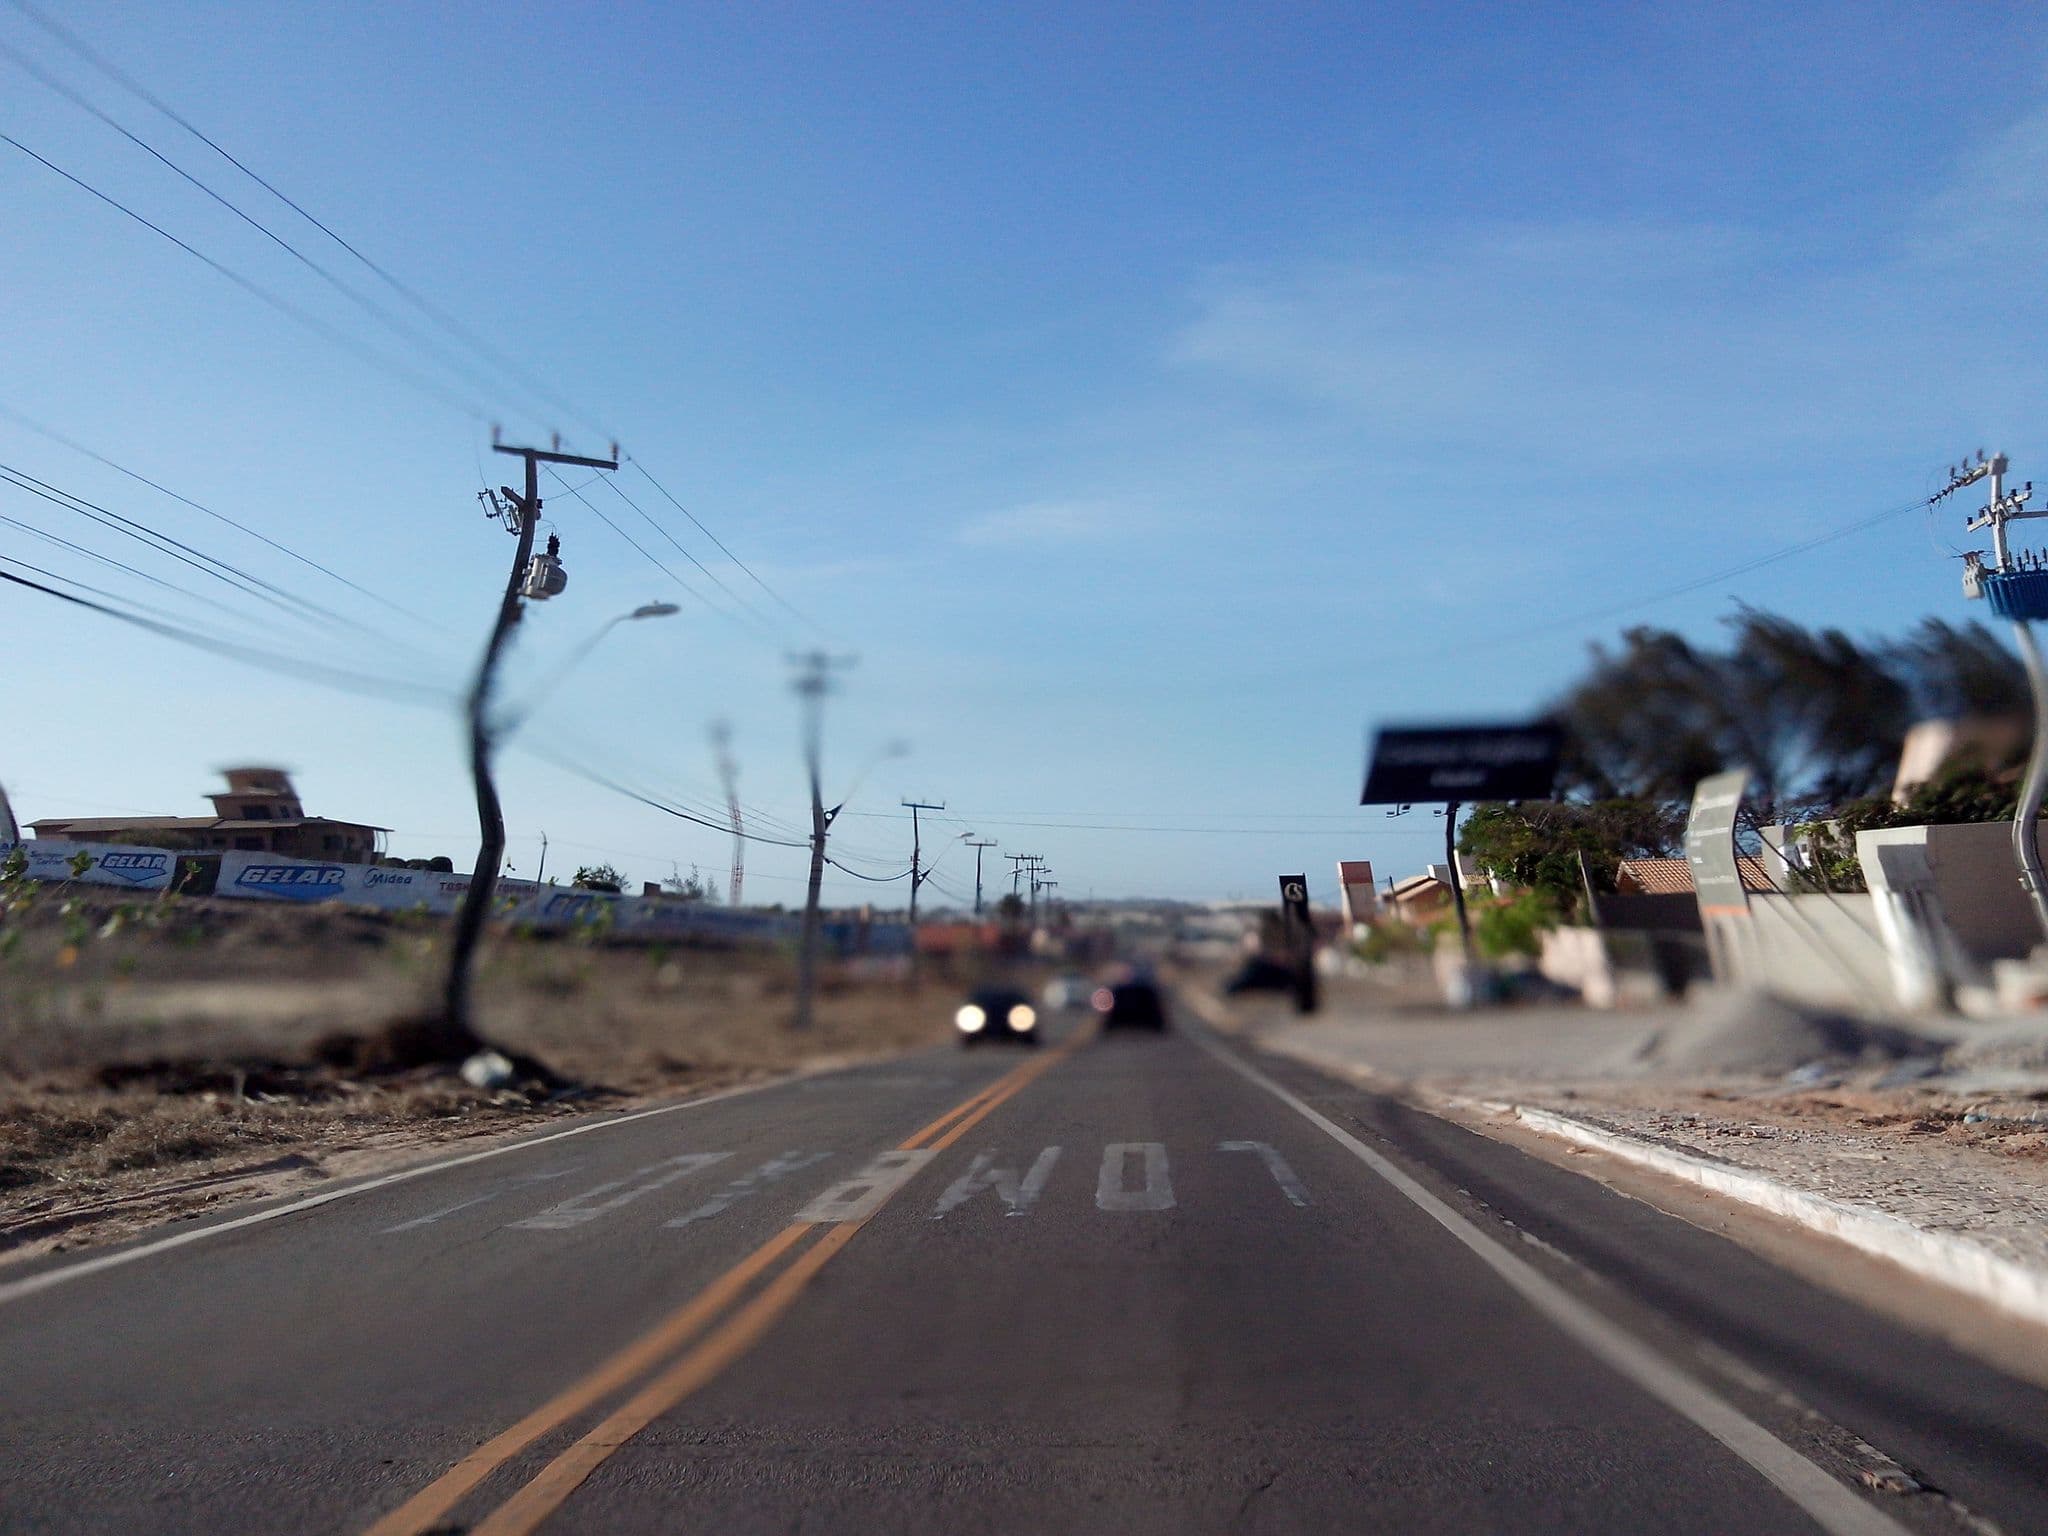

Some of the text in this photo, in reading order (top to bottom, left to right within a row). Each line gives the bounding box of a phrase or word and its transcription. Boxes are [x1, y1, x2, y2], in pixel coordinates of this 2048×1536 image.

[104, 855, 162, 868] GELAR
[241, 868, 344, 884] GELAR
[368, 871, 412, 885] Midea
